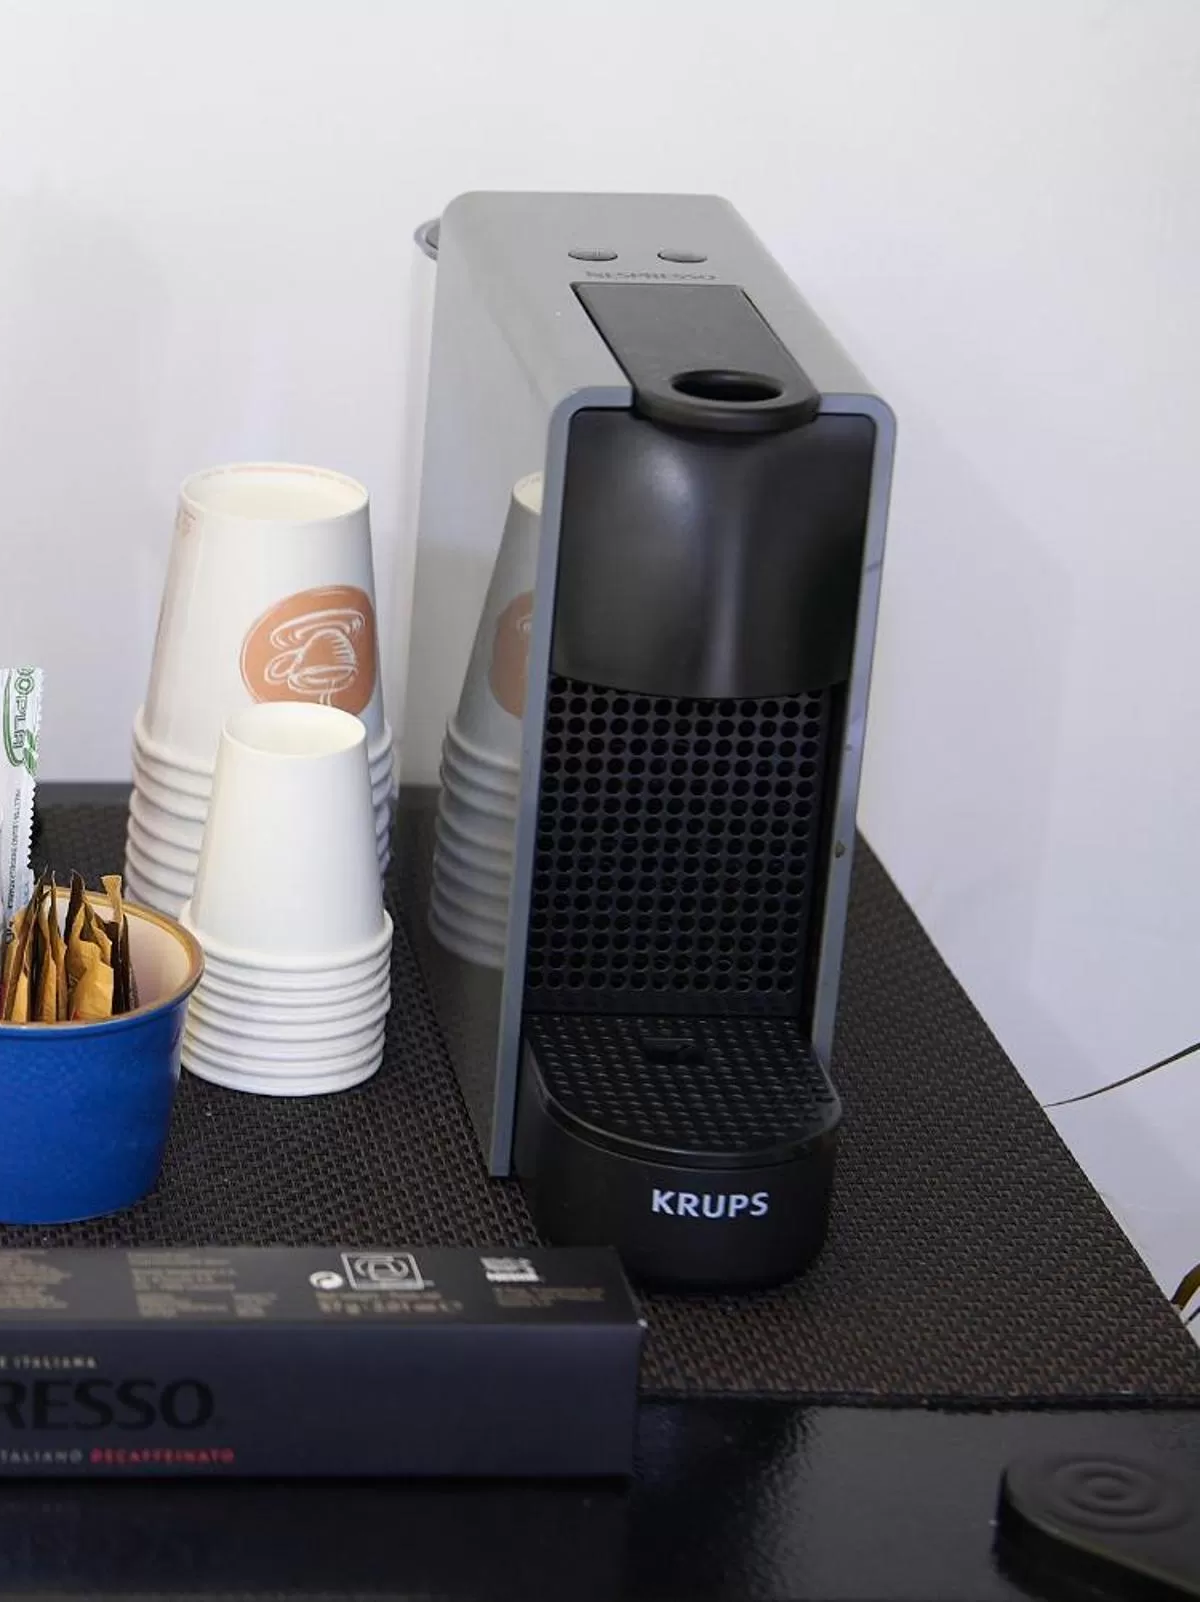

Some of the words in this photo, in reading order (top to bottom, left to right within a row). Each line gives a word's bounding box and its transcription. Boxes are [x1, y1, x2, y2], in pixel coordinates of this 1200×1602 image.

[652, 1188, 769, 1218] KRUPS
[13, 1355, 98, 1369] ITALIANA
[89, 1448, 235, 1465] DECAFFEINATO
